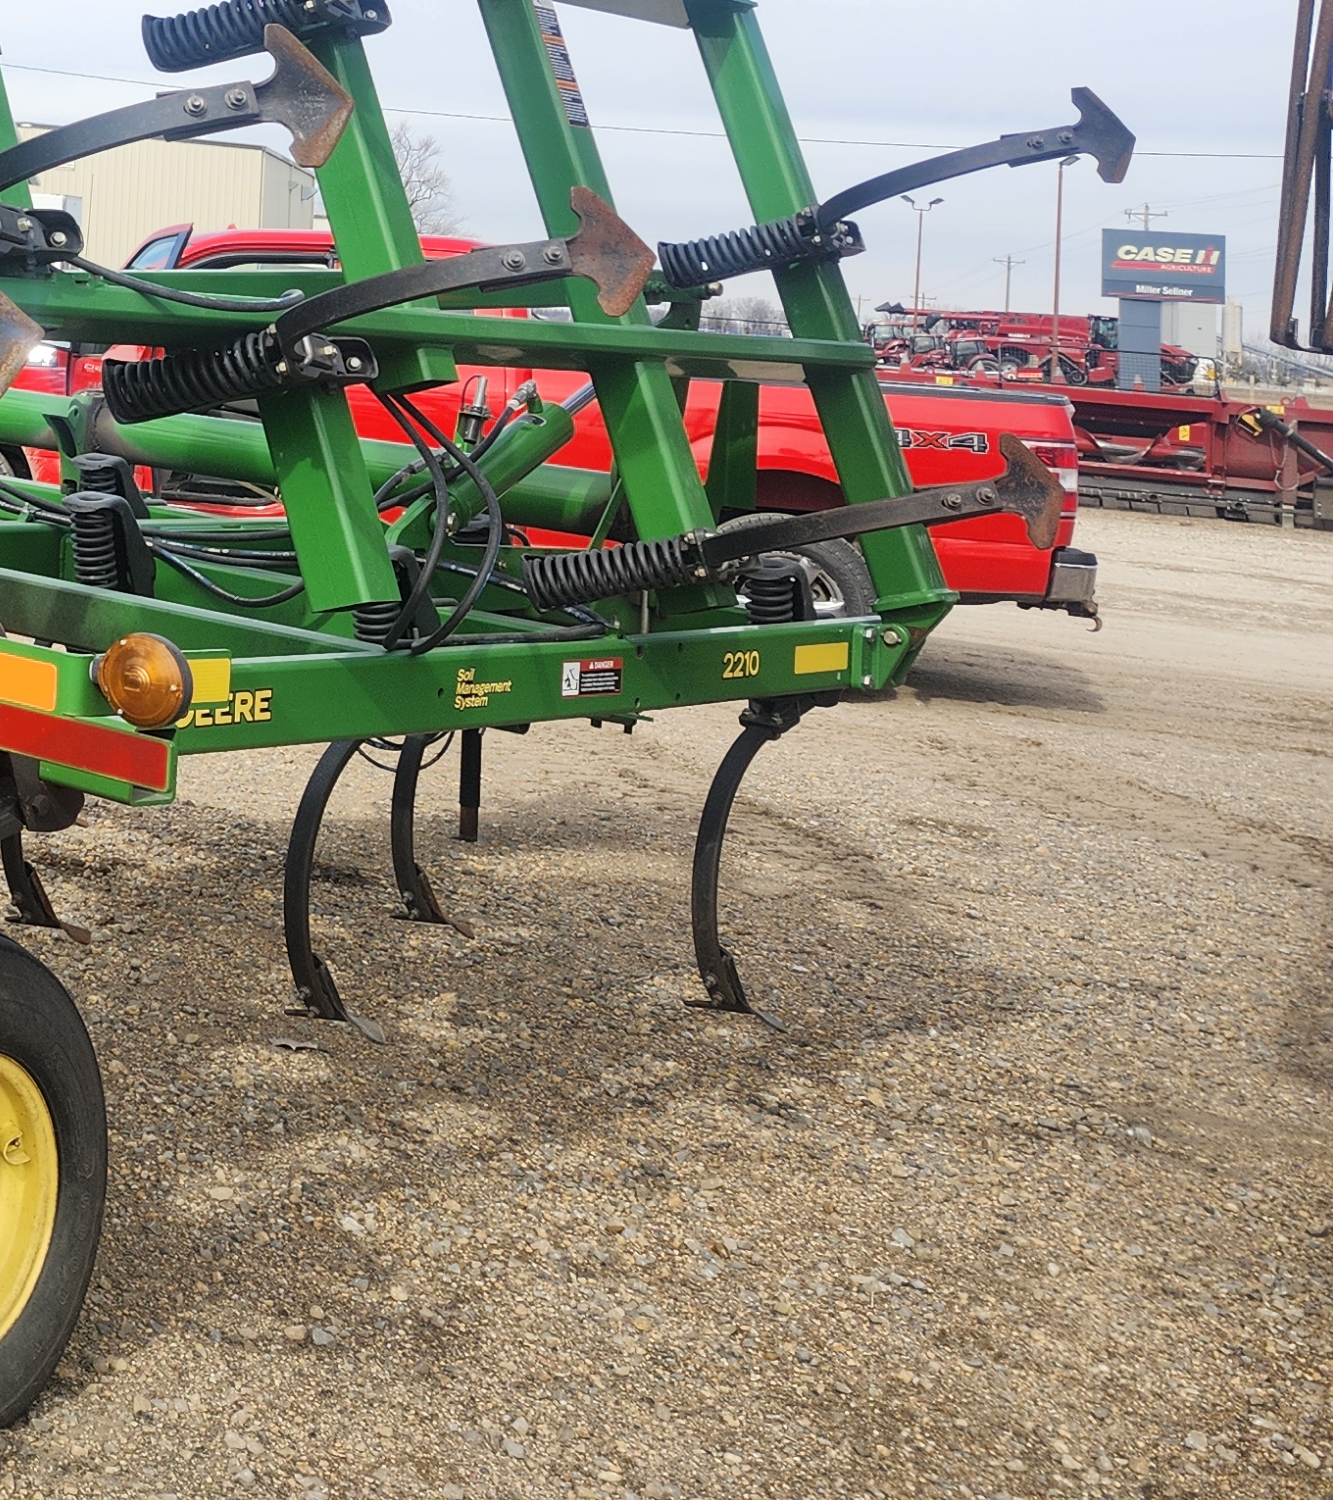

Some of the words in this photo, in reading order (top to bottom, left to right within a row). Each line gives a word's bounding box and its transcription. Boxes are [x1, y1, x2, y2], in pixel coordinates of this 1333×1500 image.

[1117, 245, 1193, 263] CASE
[1160, 264, 1213, 274] AGRICULTURE
[1136, 284, 1160, 295] Miller
[1162, 286, 1193, 297] Sellner
[722, 650, 760, 679] 2210
[457, 667, 475, 681] Soil
[455, 680, 512, 696] Management
[454, 695, 488, 710] System
